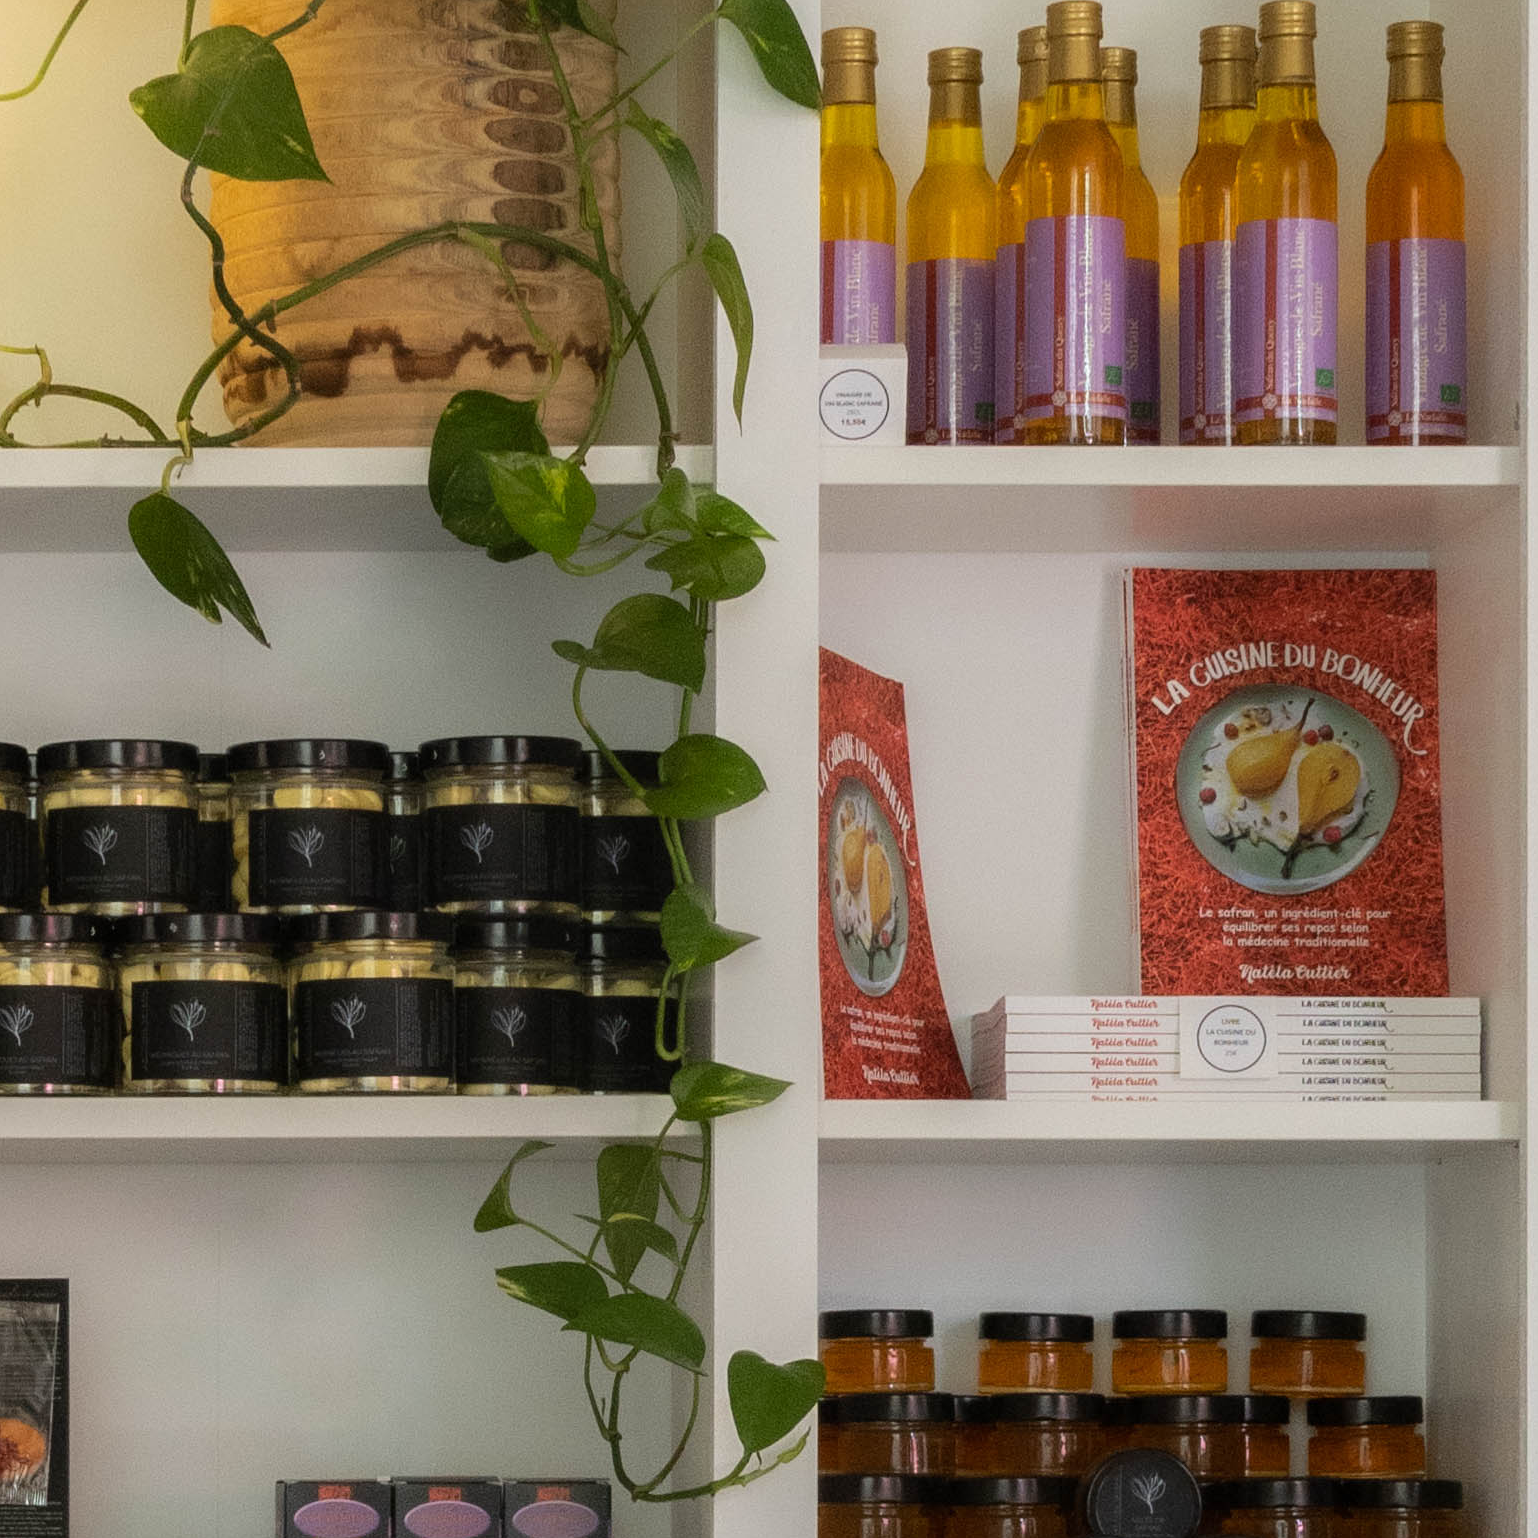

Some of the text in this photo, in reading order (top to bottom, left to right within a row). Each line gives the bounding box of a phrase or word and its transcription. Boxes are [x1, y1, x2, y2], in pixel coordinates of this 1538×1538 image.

[1150, 640, 1429, 757] LA CUISINE DU BONHEUR
[826, 732, 856, 773] CUISINE
[1199, 907, 1213, 918] Le
[1218, 907, 1259, 920] safran,
[1264, 909, 1278, 918] un
[1366, 909, 1391, 921] pour
[1222, 921, 1370, 935] équilibrer ses repas selon
[1222, 935, 1370, 947] la médecine traditionnelle
